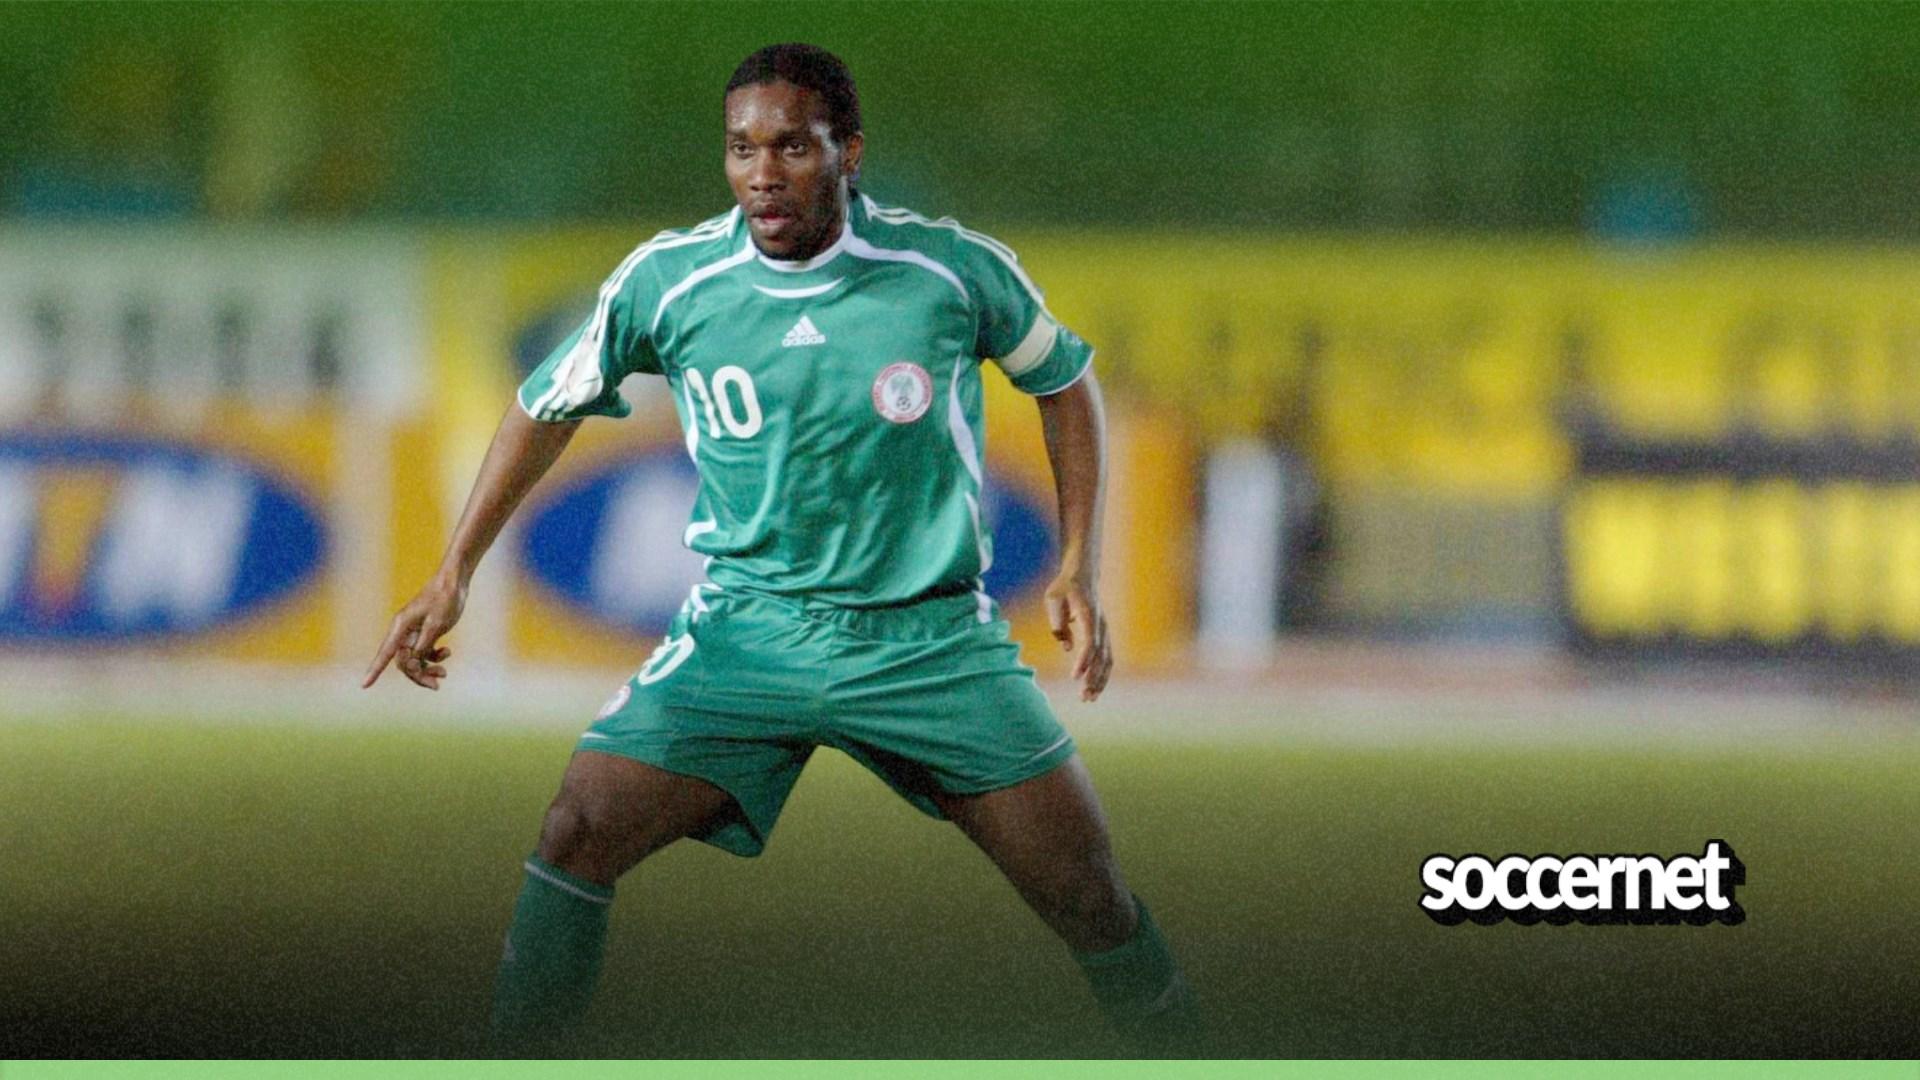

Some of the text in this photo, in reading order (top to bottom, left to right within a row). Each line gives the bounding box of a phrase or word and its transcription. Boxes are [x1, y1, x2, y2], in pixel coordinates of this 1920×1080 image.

[782, 333, 827, 348] adidas
[686, 365, 763, 439] 10
[0, 460, 256, 622] TN
